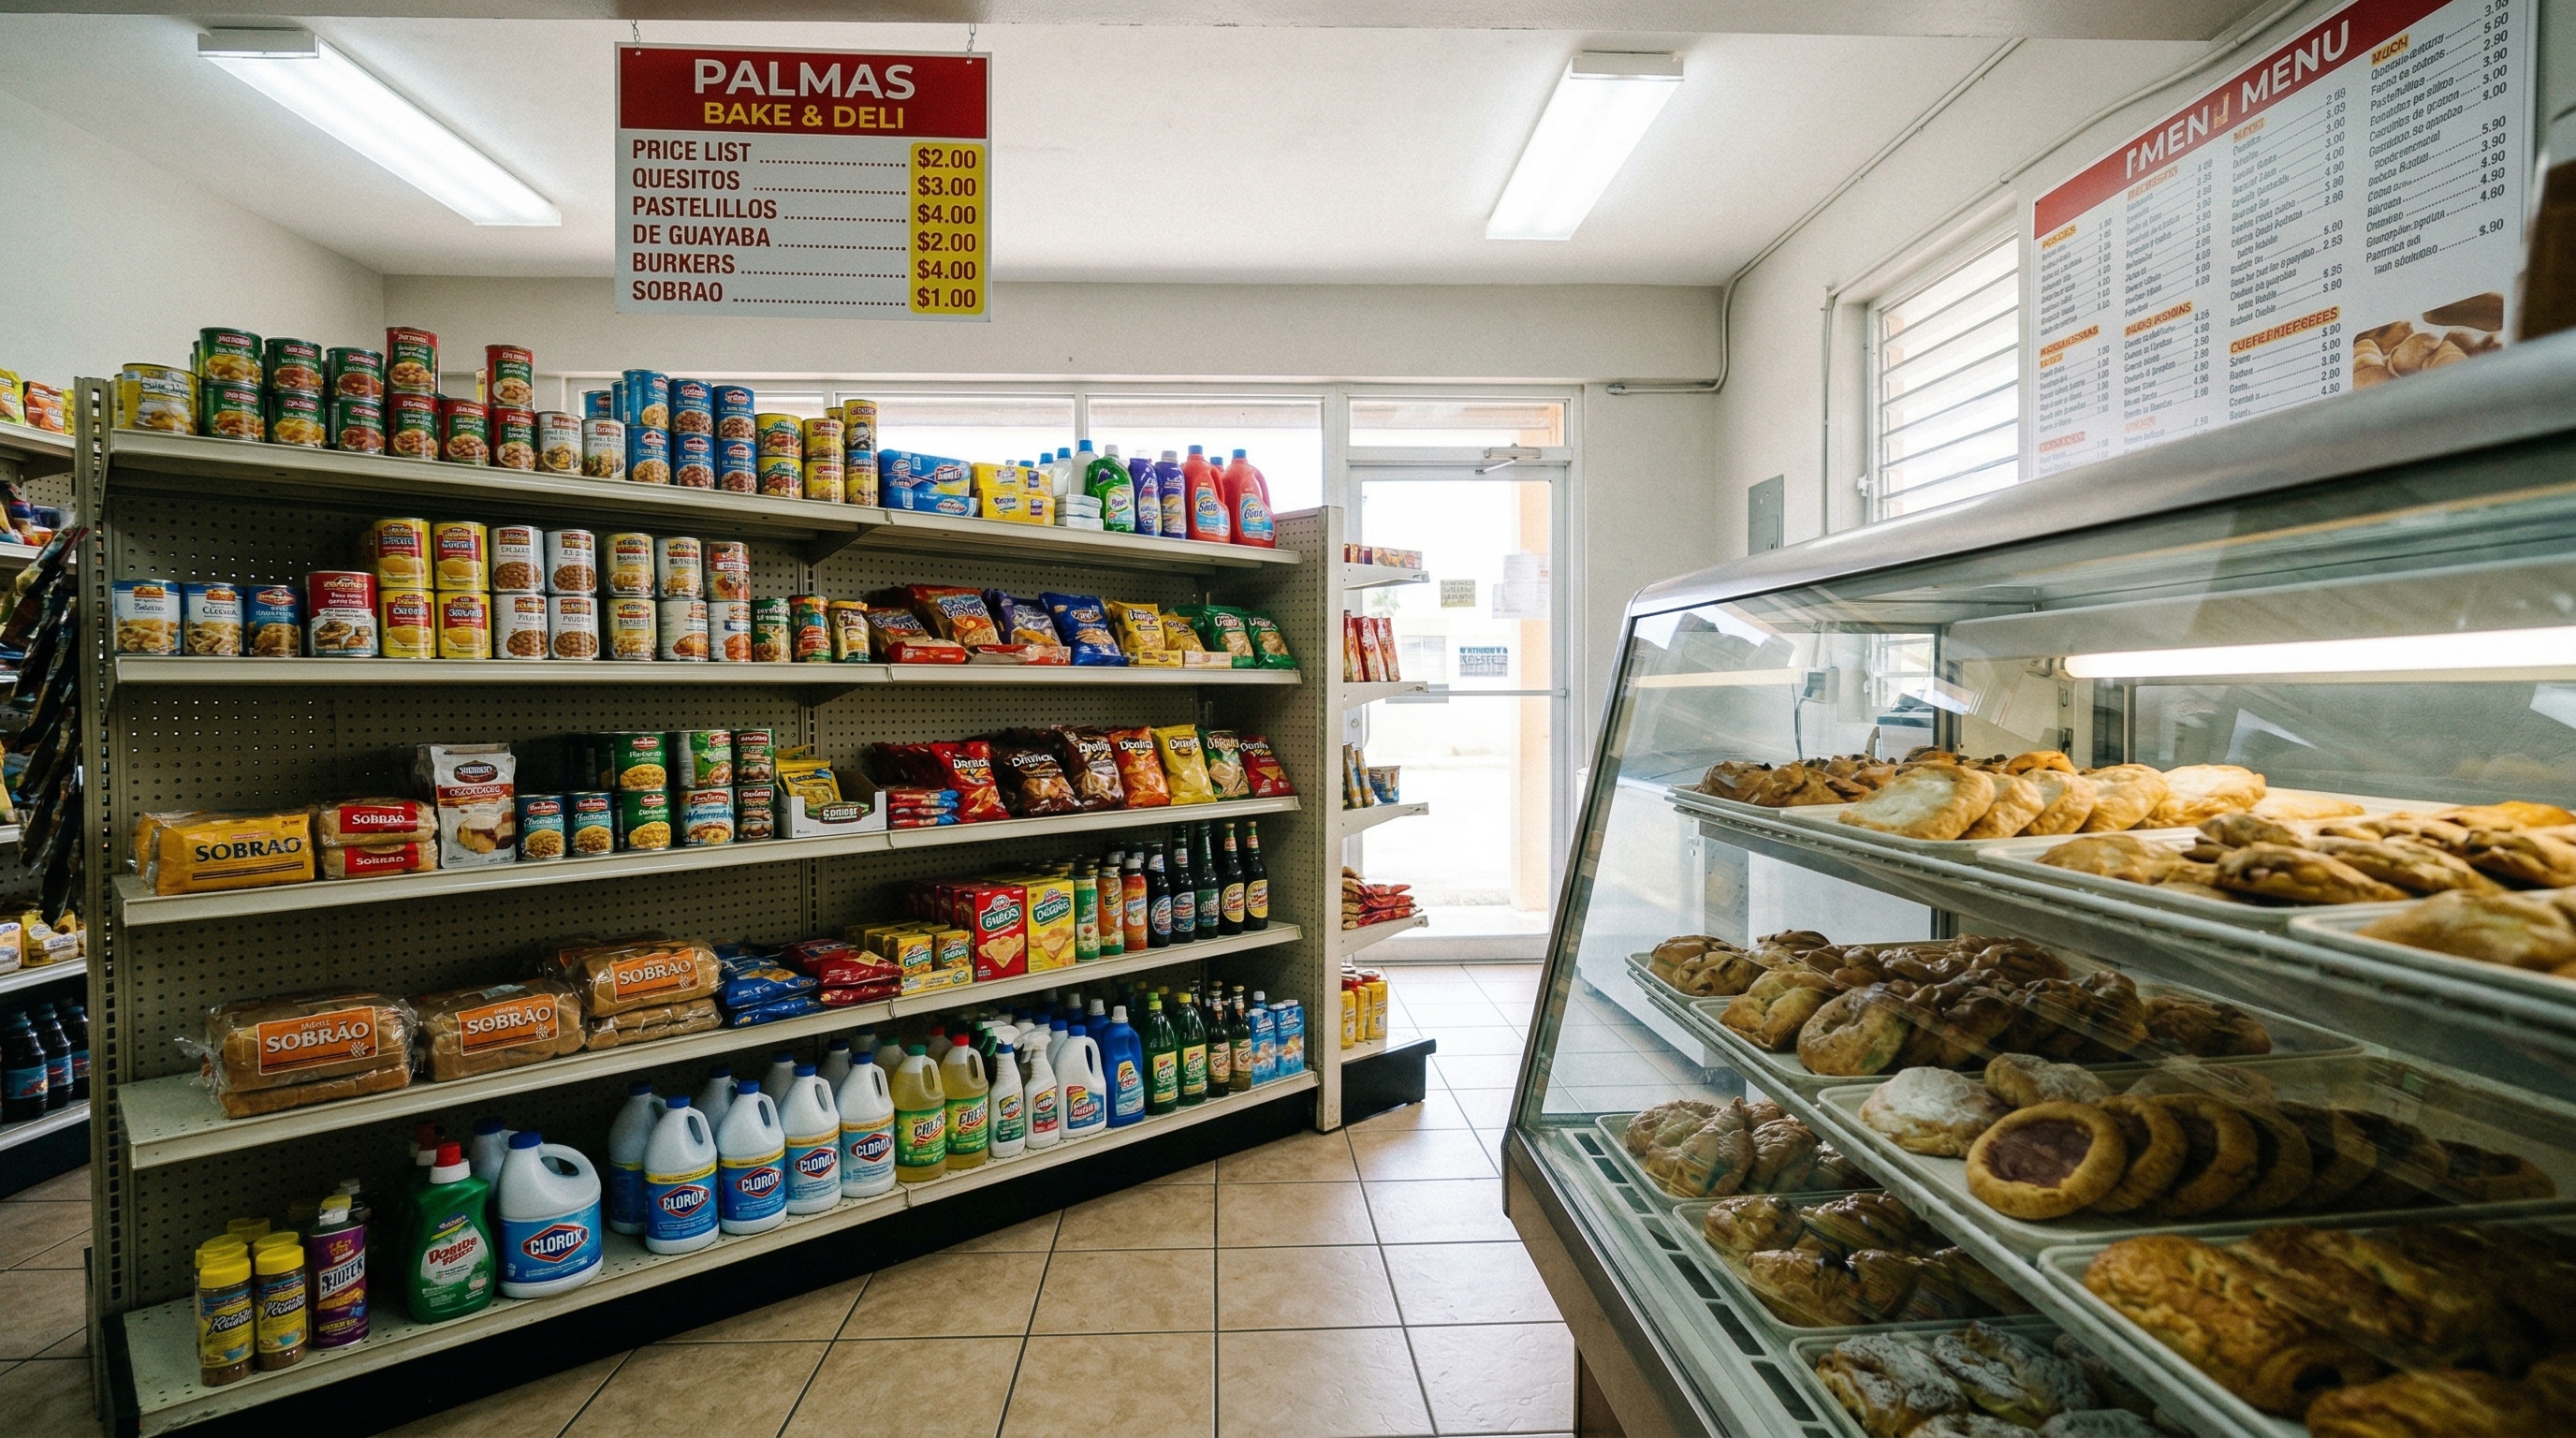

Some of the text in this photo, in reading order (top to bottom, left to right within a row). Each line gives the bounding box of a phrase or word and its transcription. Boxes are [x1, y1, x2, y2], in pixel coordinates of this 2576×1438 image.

[695, 58, 915, 100] PALMAS
[2242, 20, 2349, 113] MENU
[704, 102, 904, 130] BAKE & DELI
[2481, 115, 2506, 135] 5.90
[632, 139, 977, 170] PRICE LIST $2.00
[2481, 133, 2506, 152] 3.90
[2481, 150, 2506, 169] 4.90
[632, 168, 977, 198] QUESITOS $3.00
[2480, 167, 2505, 184] 4.90
[632, 196, 977, 226] PASTELILLOS $4.00
[632, 224, 977, 254] DE GUAYABA $2.00
[632, 252, 977, 282] BURKERS $4.00
[632, 280, 977, 310] SOBRAO $1.00
[195, 837, 302, 862] SOBRAO
[466, 1005, 551, 1035] SOBRÃO
[266, 1020, 370, 1053] SOBRÃO
